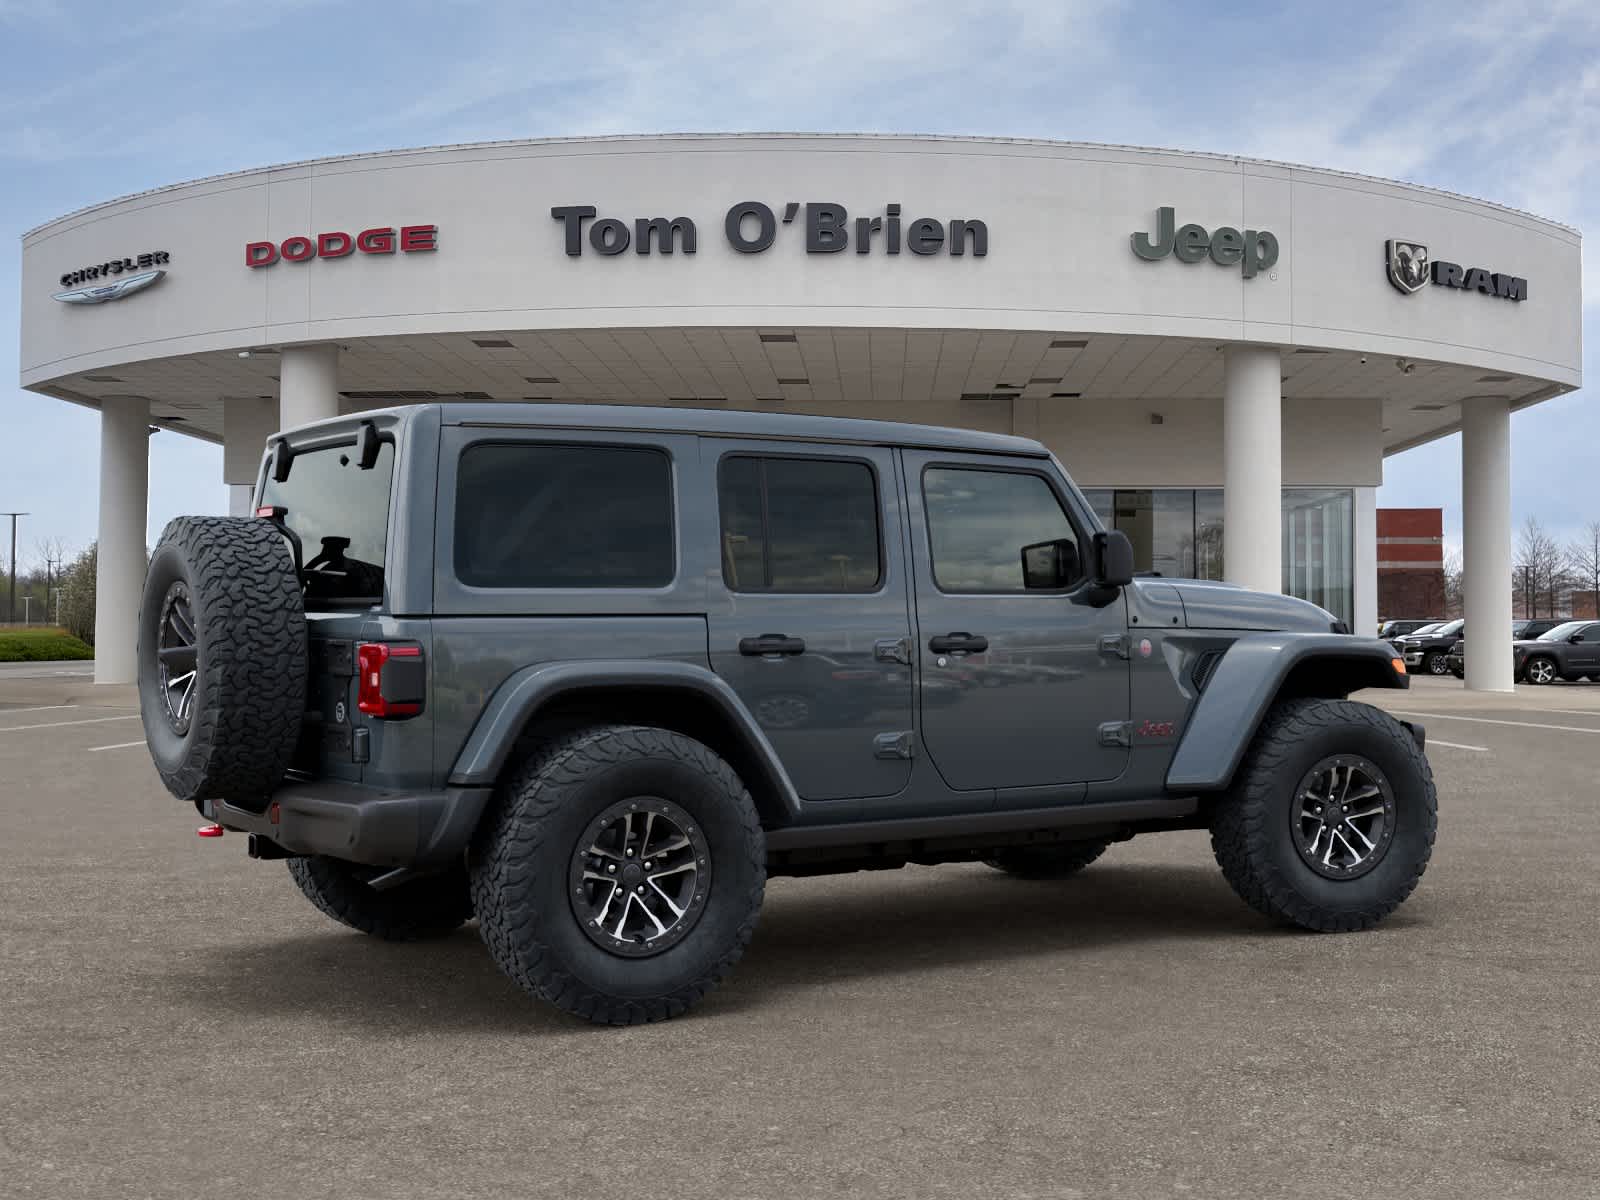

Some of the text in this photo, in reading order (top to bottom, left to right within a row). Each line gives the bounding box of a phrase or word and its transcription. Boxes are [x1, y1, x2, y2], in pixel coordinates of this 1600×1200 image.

[246, 224, 437, 269] DODGE
[551, 201, 988, 257] Tom O'Brien
[1130, 207, 1279, 279] Jeep
[60, 250, 170, 287] CHRYSLER
[1431, 260, 1527, 302] RAM
